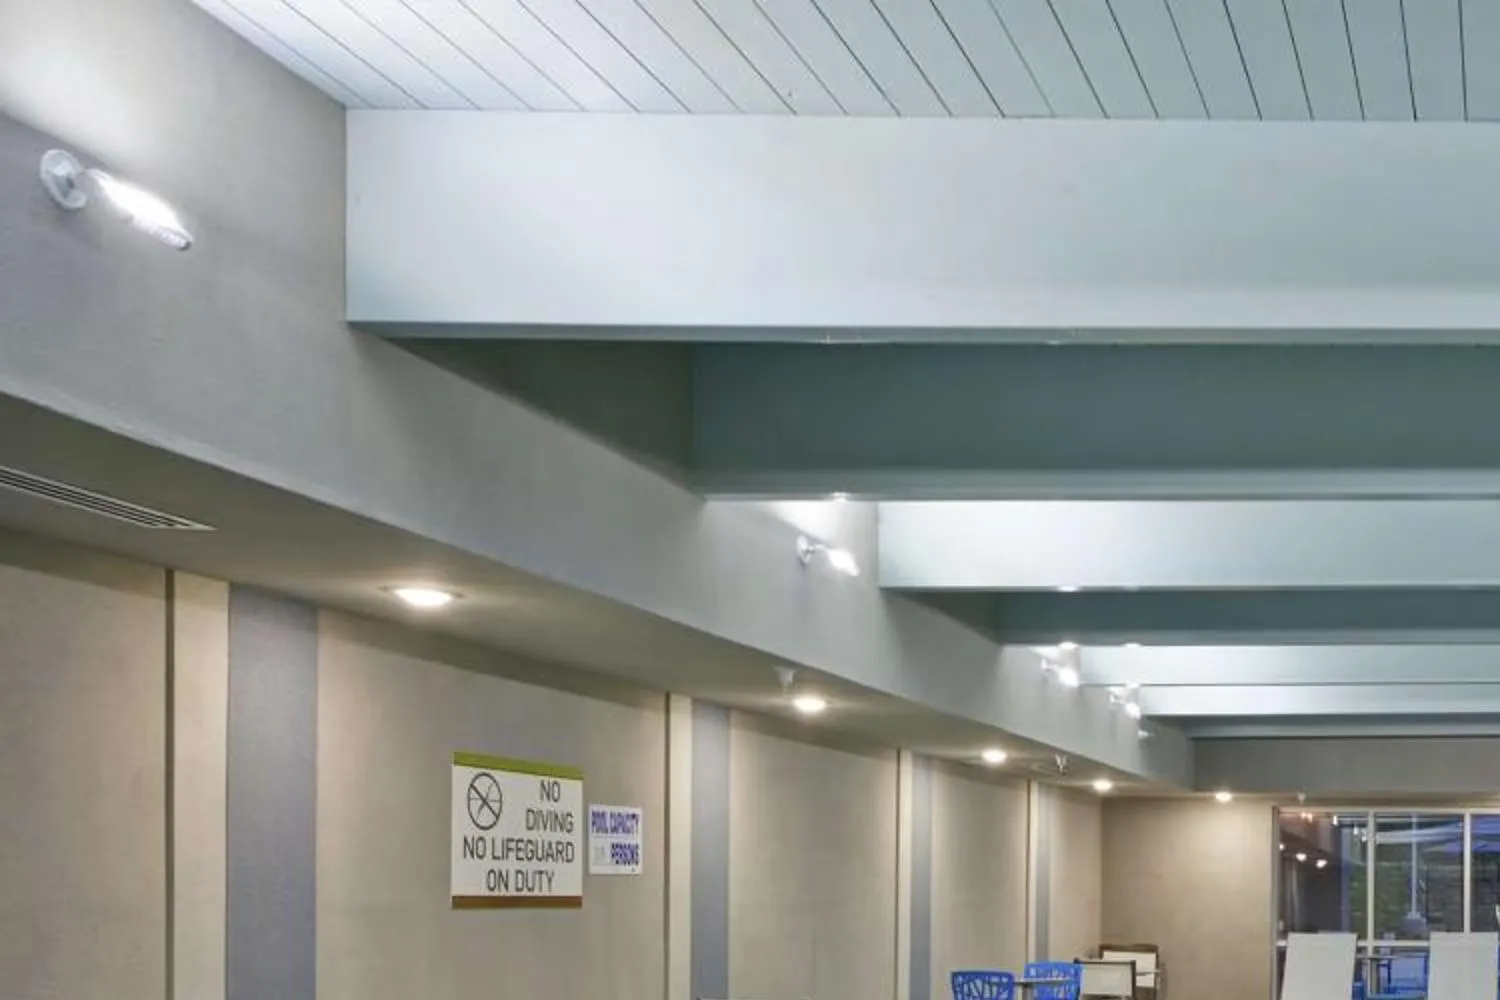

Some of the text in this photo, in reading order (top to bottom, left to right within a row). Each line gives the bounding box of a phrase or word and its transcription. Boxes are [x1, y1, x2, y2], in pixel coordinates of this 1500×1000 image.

[540, 780, 561, 803] NO
[525, 808, 575, 833] DIVING
[463, 835, 487, 859] NO
[491, 836, 575, 863] LIFEGUARD
[487, 868, 554, 892] ON DUTY
